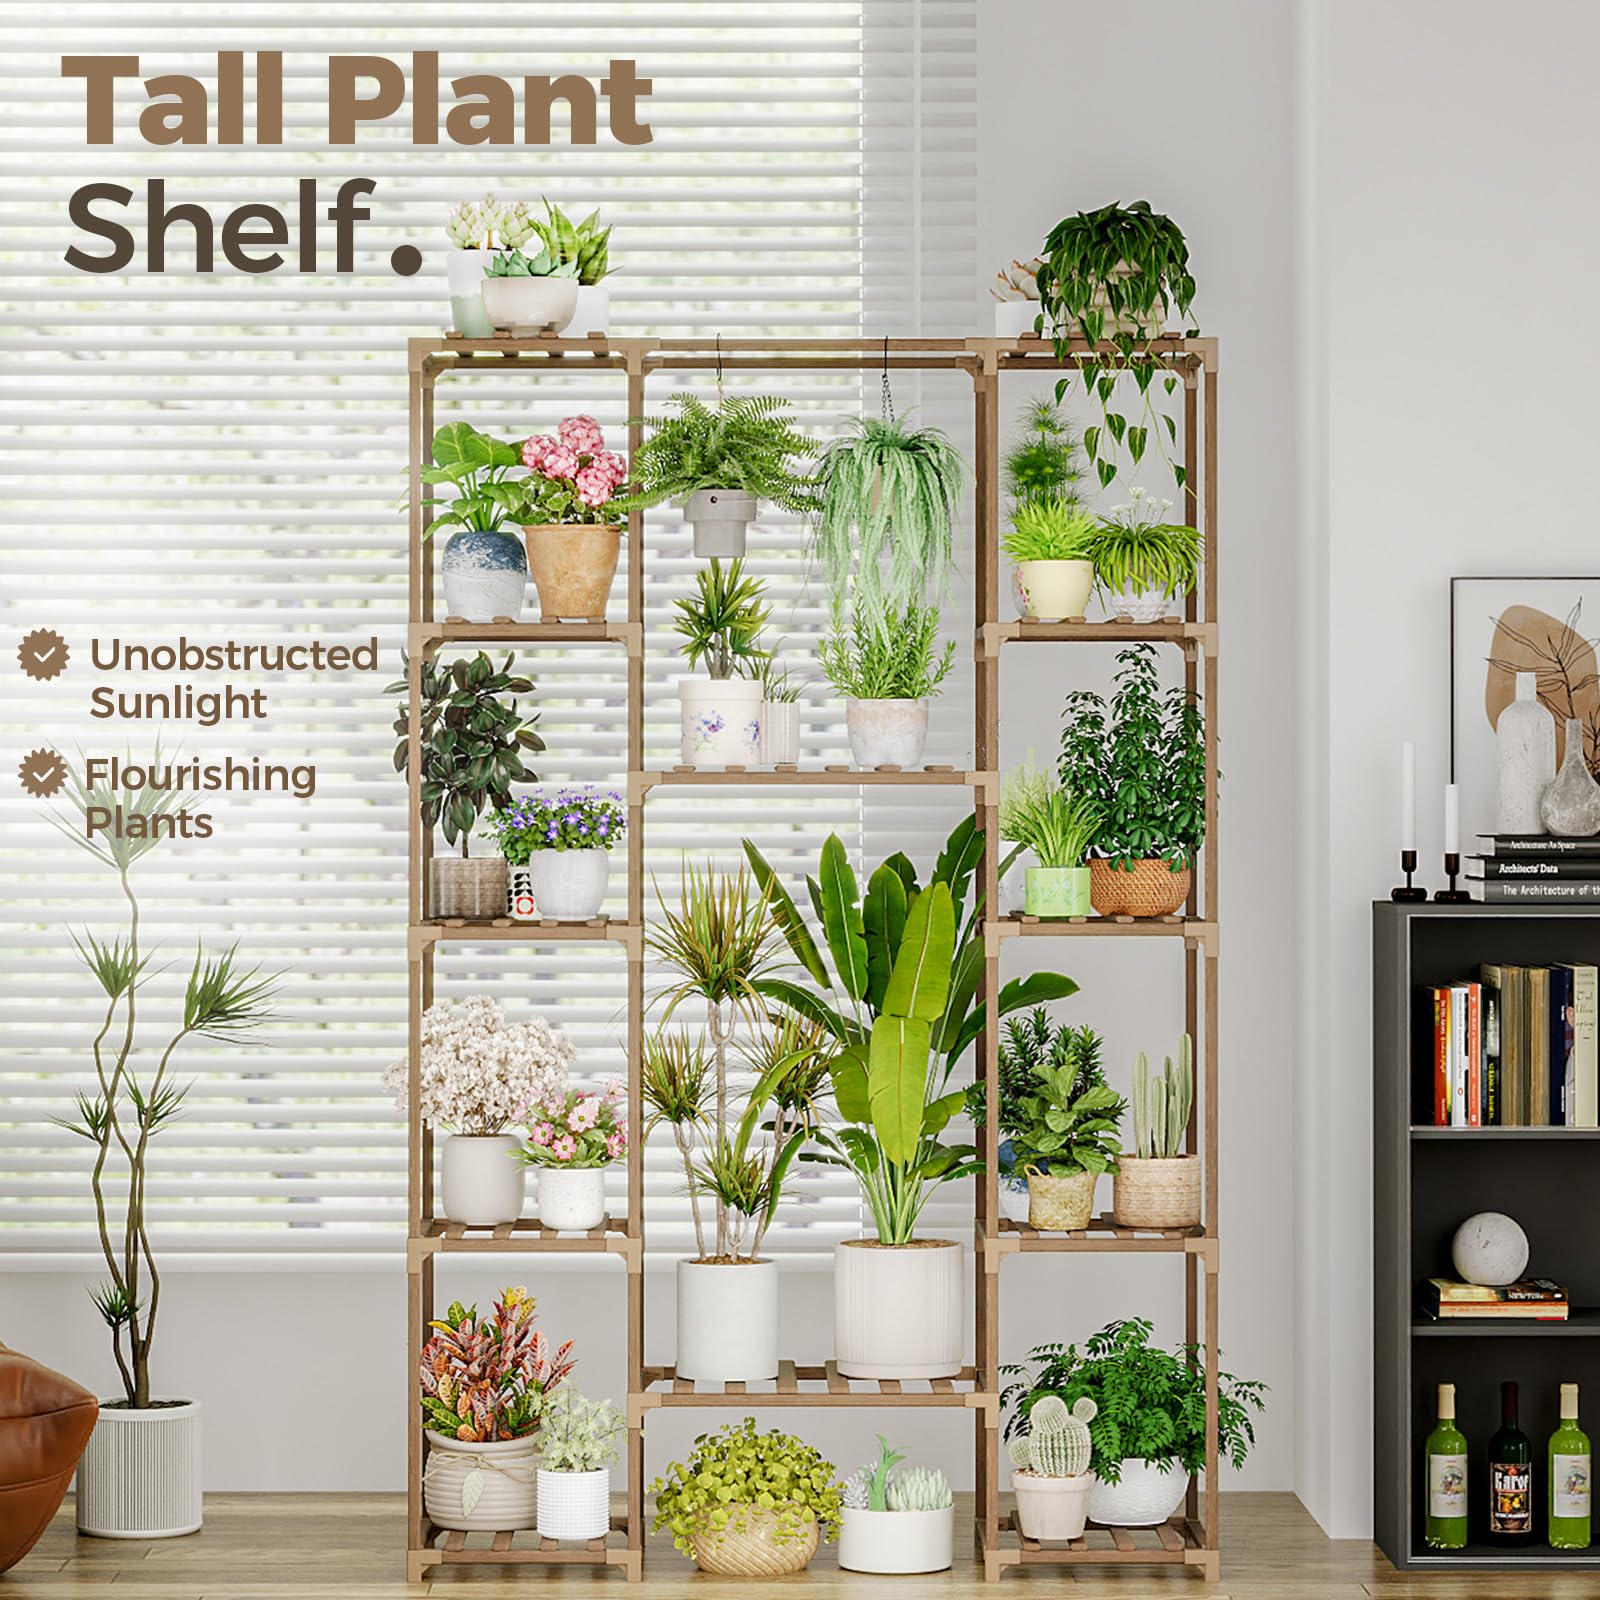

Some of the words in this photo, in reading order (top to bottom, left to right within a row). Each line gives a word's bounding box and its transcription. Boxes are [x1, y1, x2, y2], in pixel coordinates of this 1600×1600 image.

[1540, 864, 1558, 873] Data
[1503, 885, 1517, 895] The
[1520, 885, 1575, 895] Architecture
[1578, 884, 1589, 895] of
